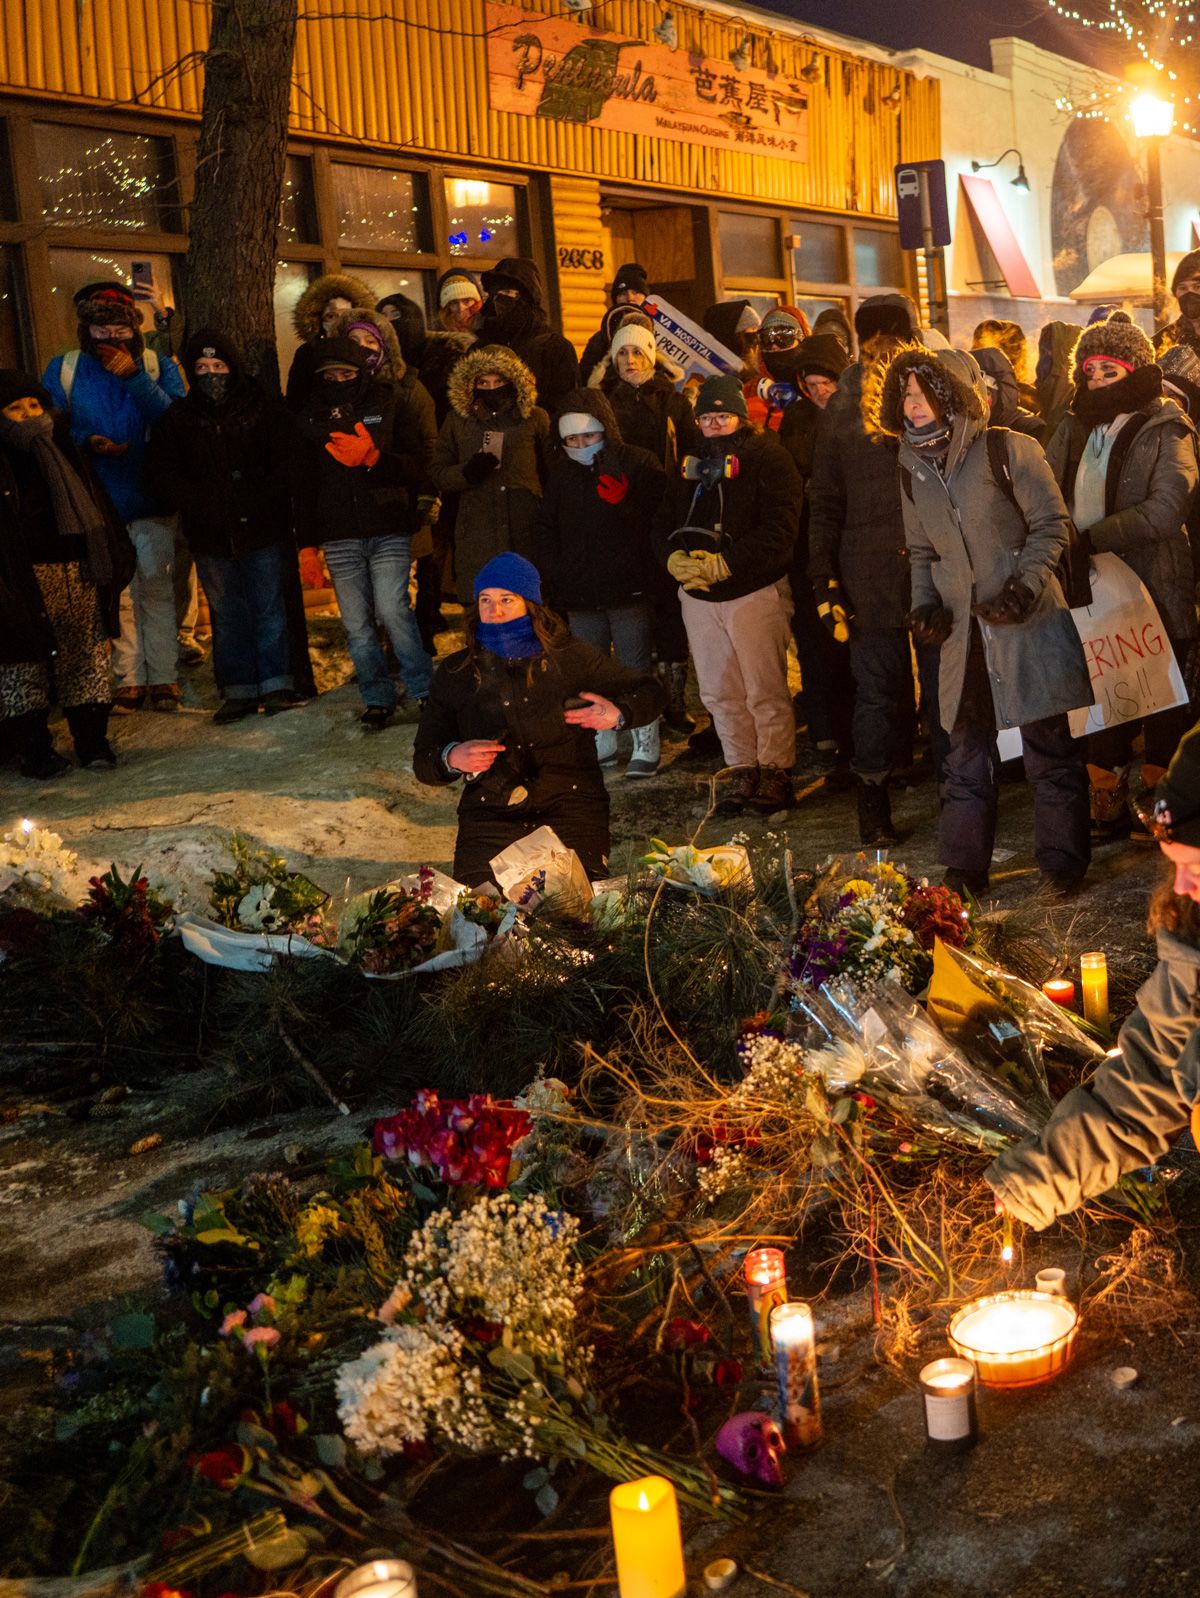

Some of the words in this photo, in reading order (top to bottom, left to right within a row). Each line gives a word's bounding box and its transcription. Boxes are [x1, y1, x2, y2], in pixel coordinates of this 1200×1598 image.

[512, 33, 658, 103] Peninsula
[657, 336, 690, 365] PRETTI
[660, 314, 672, 329] VA
[674, 327, 713, 360] HOSPITAL
